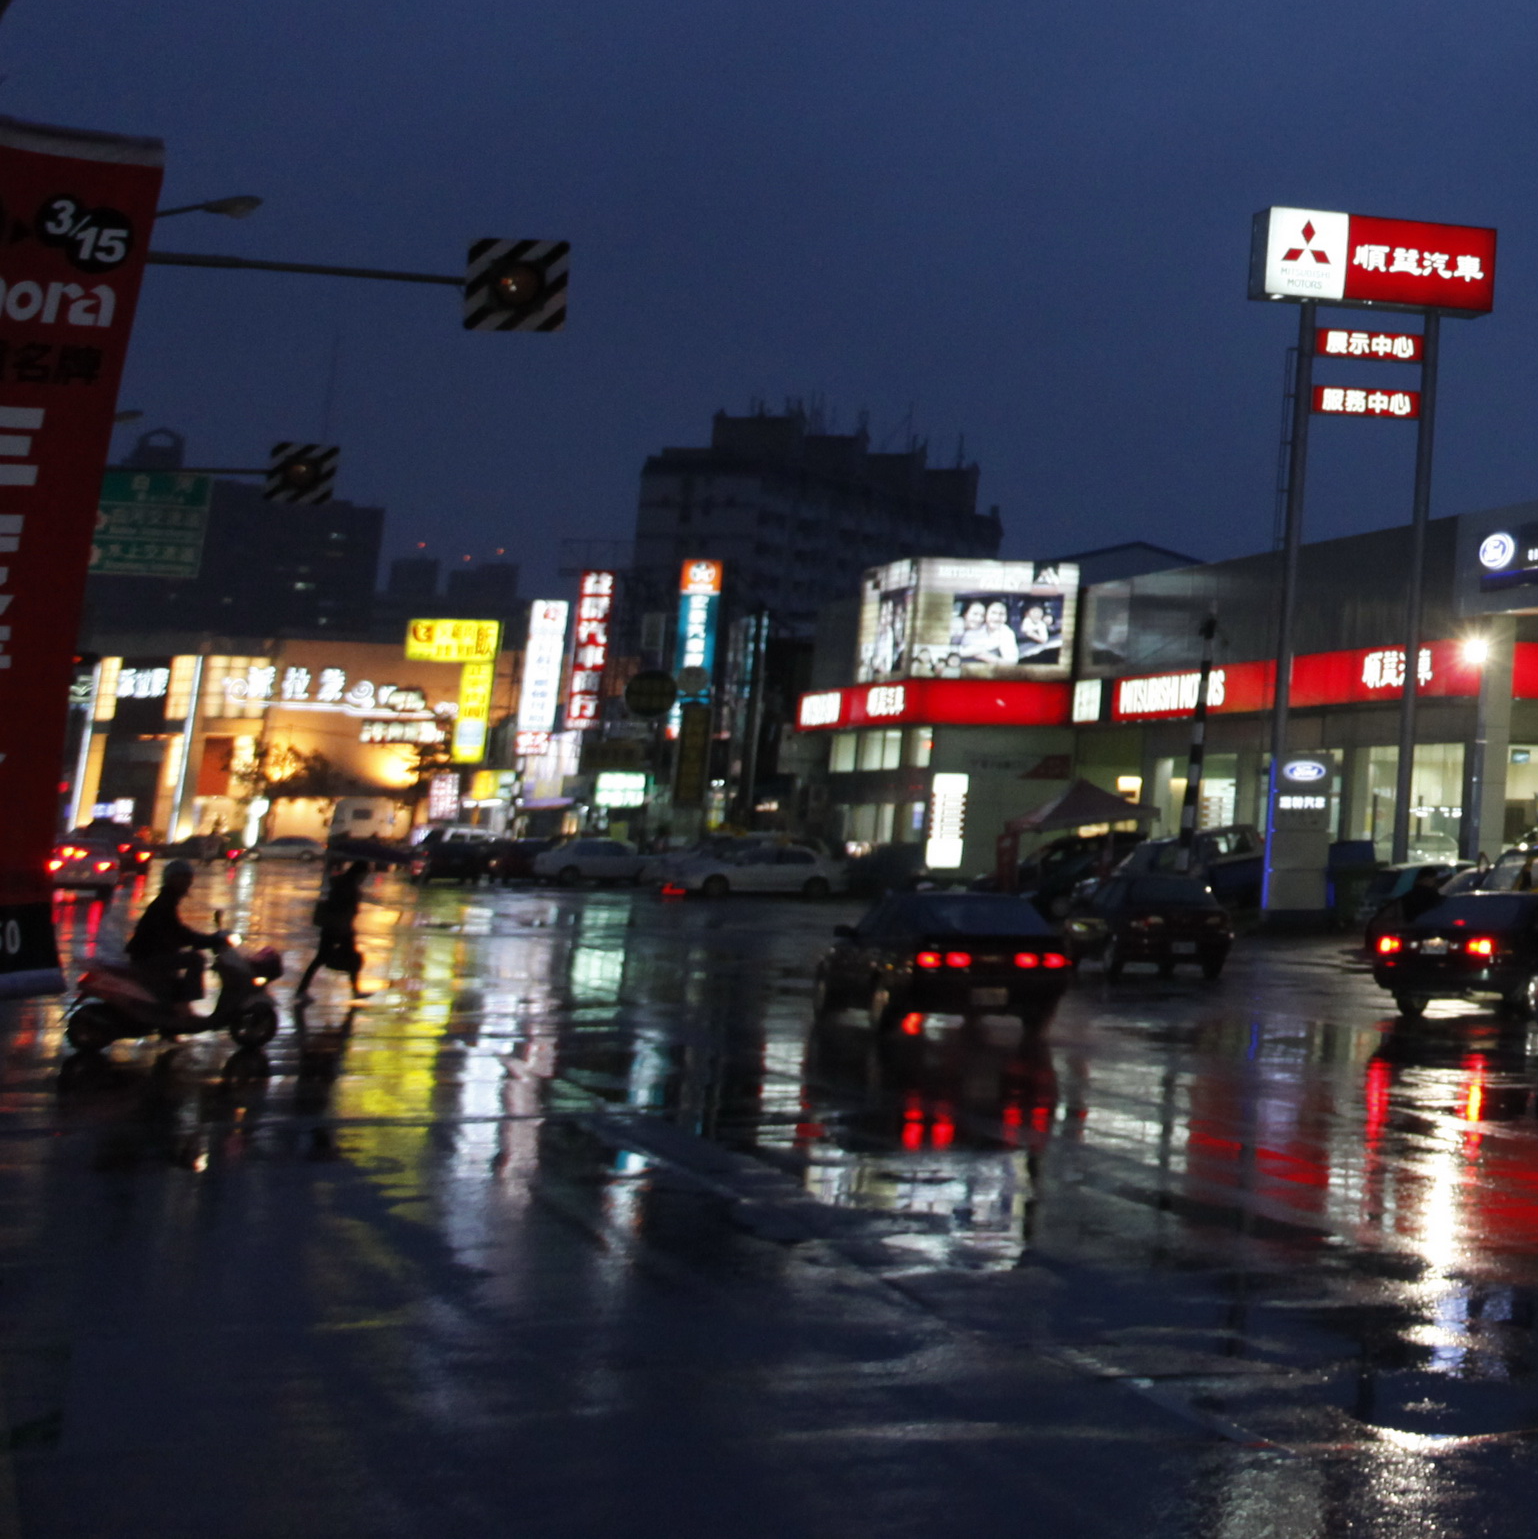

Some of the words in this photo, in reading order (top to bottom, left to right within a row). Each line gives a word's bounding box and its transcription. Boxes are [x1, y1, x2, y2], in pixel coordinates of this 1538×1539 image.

[45, 199, 129, 262] 3/15
[1280, 266, 1331, 279] MITSUBISHI
[1286, 277, 1323, 290] MOTORS
[0, 277, 117, 327] ora
[1325, 330, 1415, 359] 展示中心
[0, 342, 102, 385] 名牌
[1321, 387, 1412, 415] 服務中心
[1179, 669, 1226, 711] MOTRS
